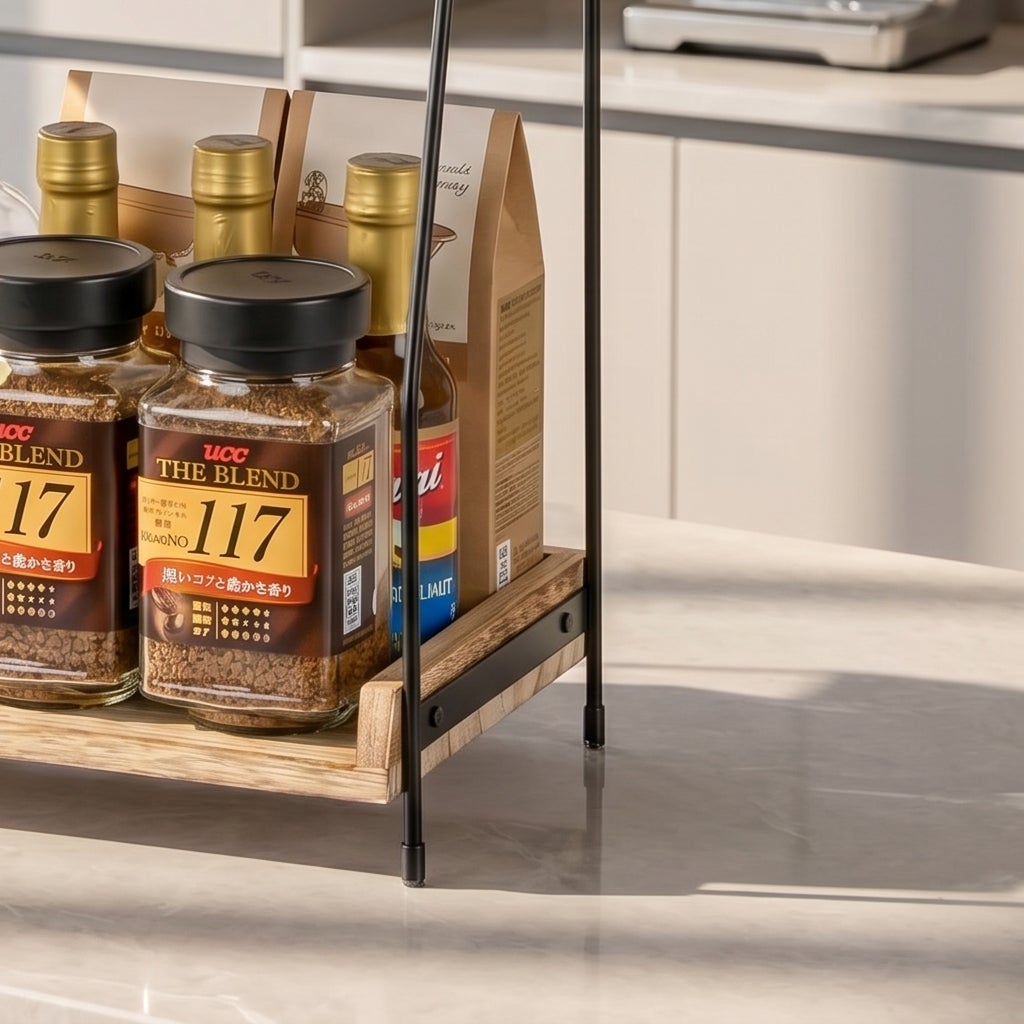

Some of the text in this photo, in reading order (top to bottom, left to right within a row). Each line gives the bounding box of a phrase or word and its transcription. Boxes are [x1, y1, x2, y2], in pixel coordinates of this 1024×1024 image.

[156, 457, 300, 490] THE BLEND
[188, 499, 291, 562] 117
